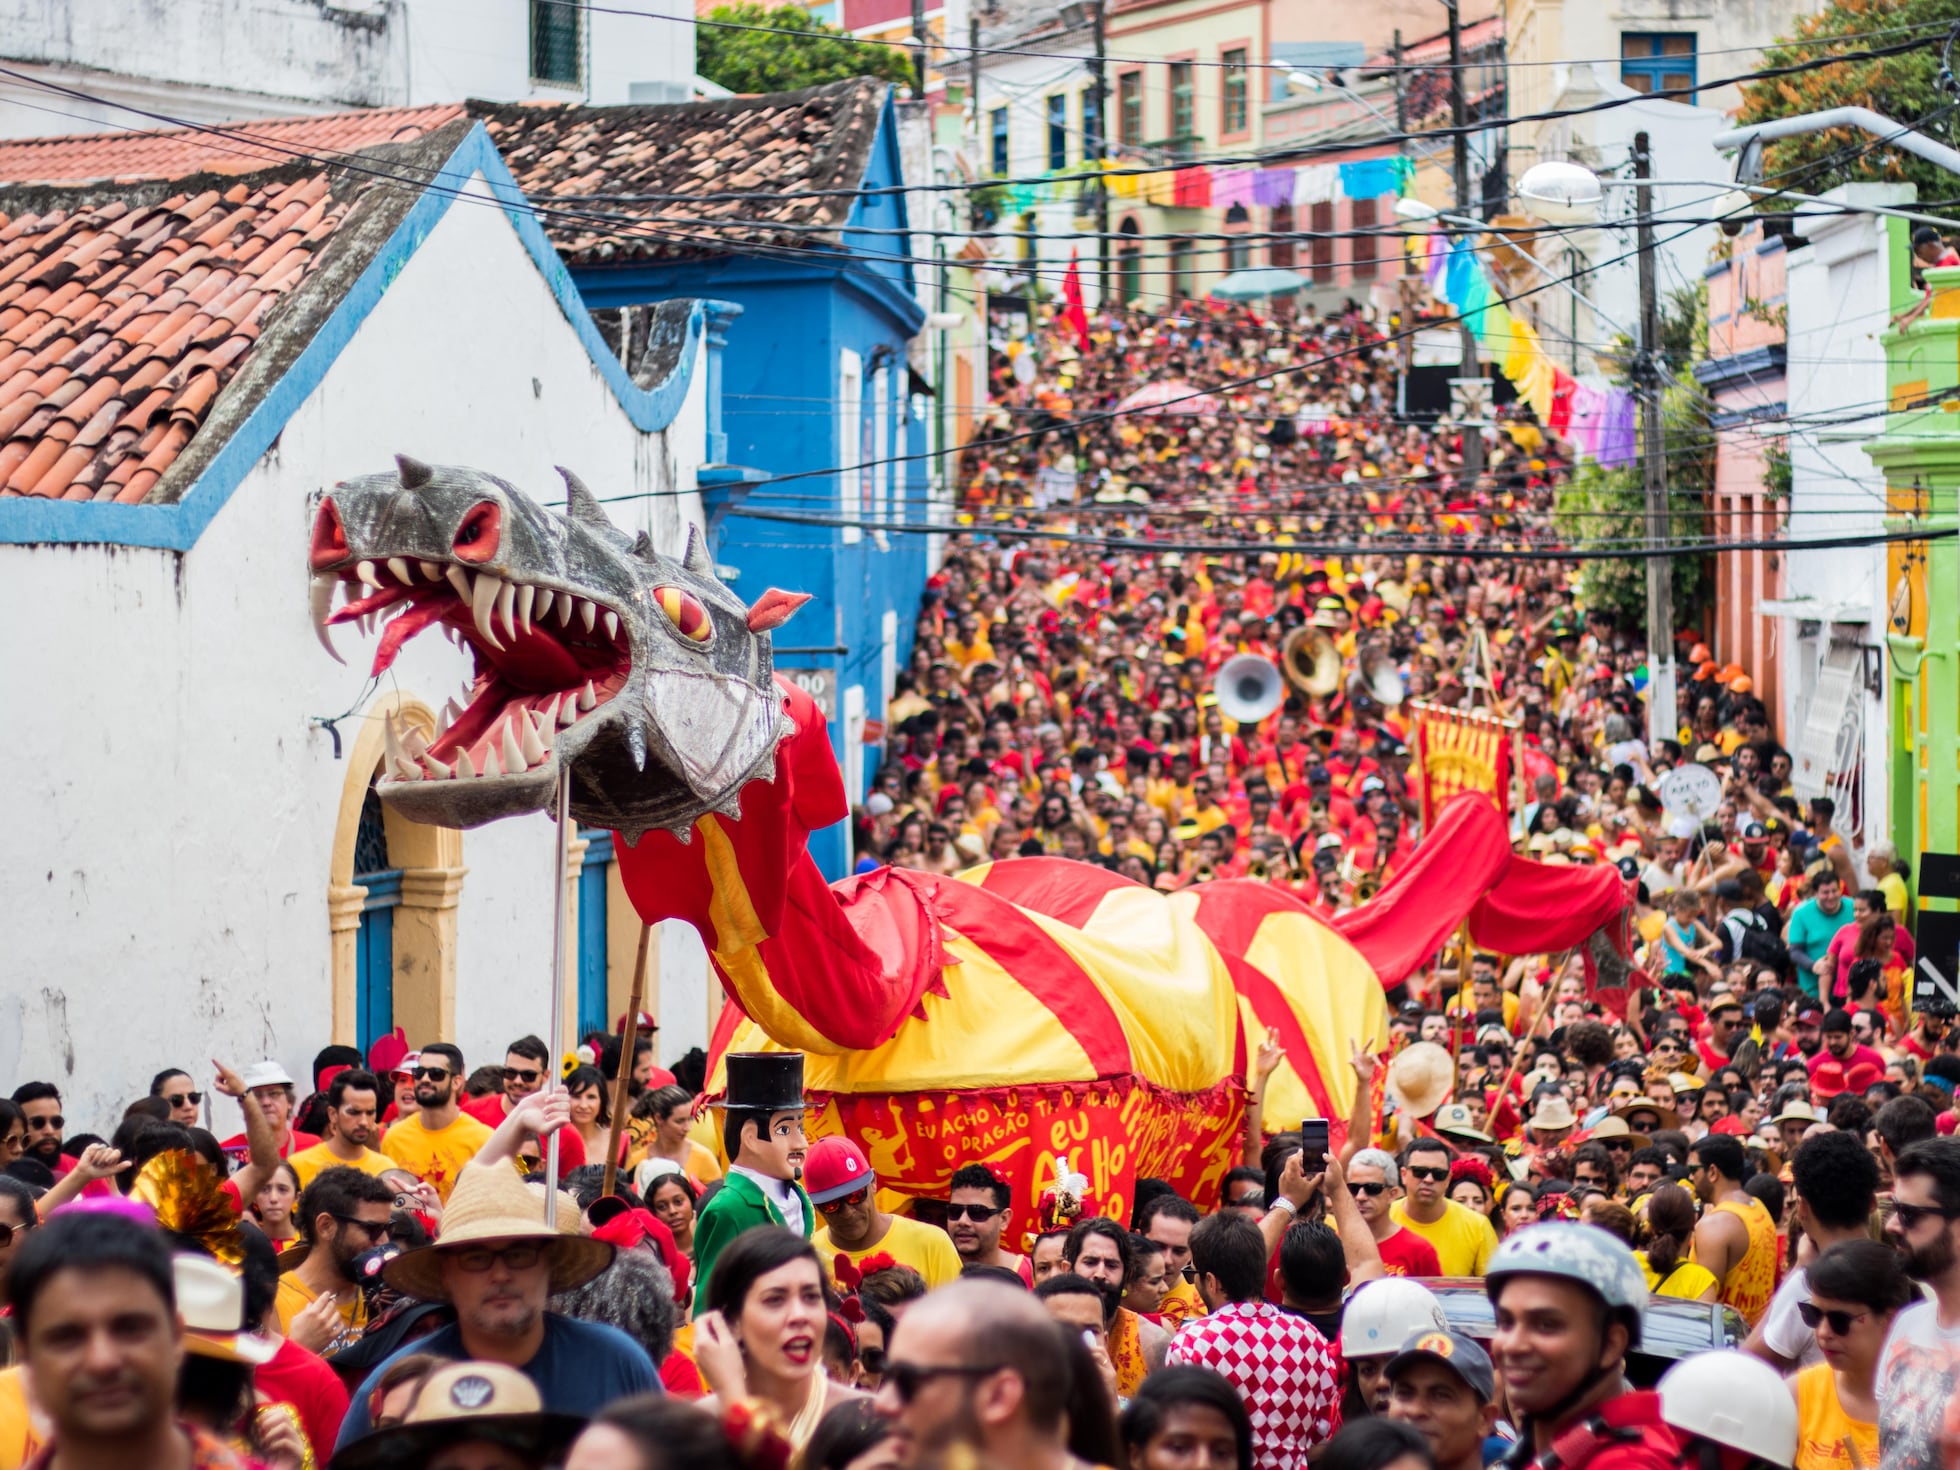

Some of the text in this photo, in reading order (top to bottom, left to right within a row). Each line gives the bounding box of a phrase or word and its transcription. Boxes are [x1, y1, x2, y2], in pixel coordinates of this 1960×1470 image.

[916, 1121, 937, 1139] EU
[941, 1108, 990, 1138] ACHO
[943, 1112, 1030, 1160] O DRAGÃO
